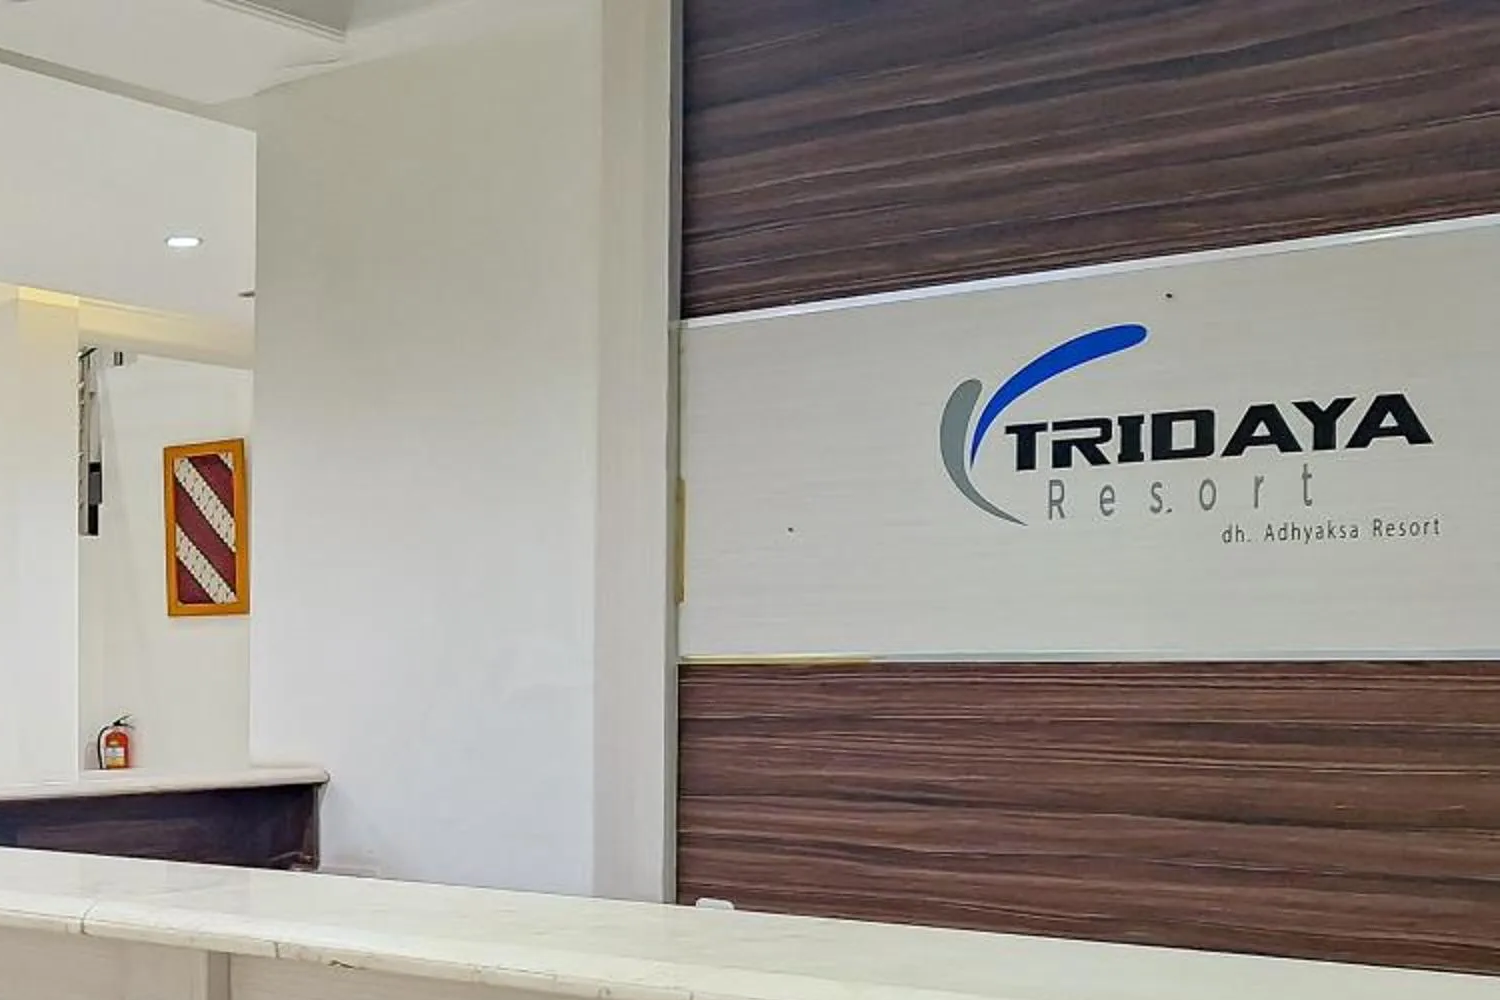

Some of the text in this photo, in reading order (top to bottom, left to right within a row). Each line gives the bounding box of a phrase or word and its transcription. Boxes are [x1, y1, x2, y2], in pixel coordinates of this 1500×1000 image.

[1004, 393, 1434, 471] TRIDAYA
[1048, 463, 1313, 520] Resort
[1221, 517, 1441, 545] dh. Adhyaksa Resort
